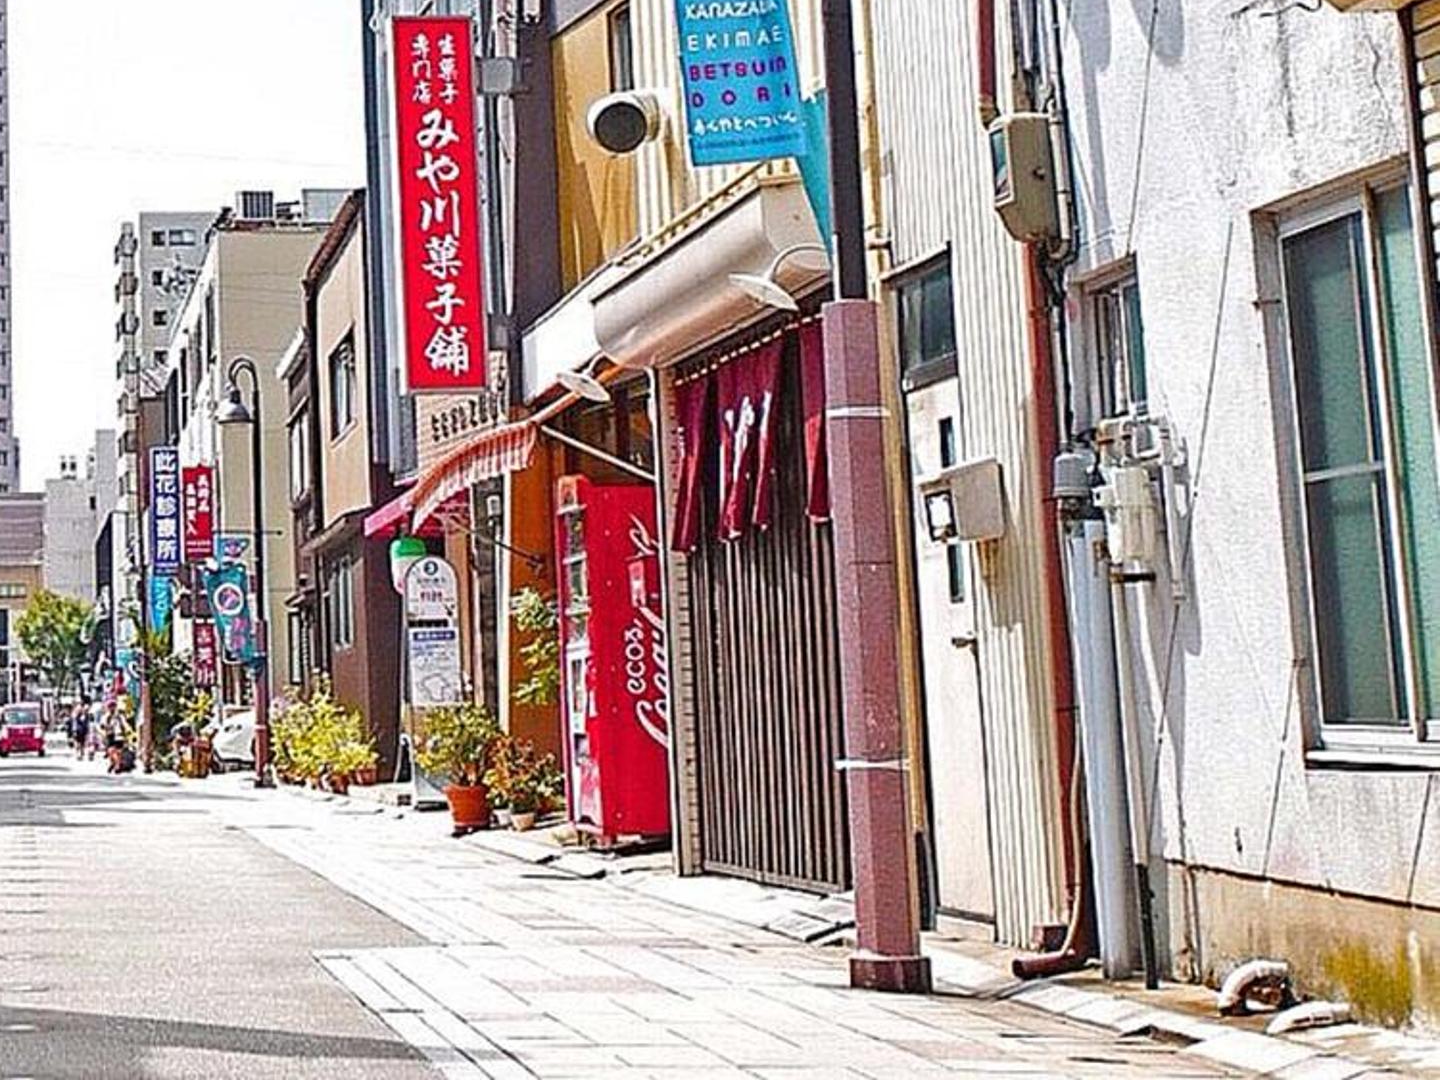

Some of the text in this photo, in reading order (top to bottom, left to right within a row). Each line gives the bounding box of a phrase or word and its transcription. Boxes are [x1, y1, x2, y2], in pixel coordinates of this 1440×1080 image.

[411, 32, 433, 106] 専門店
[437, 32, 459, 105] 生菓子
[687, 24, 784, 52] EKIMAE
[691, 82, 791, 108] DORI
[415, 107, 471, 378] みや川菓子舗
